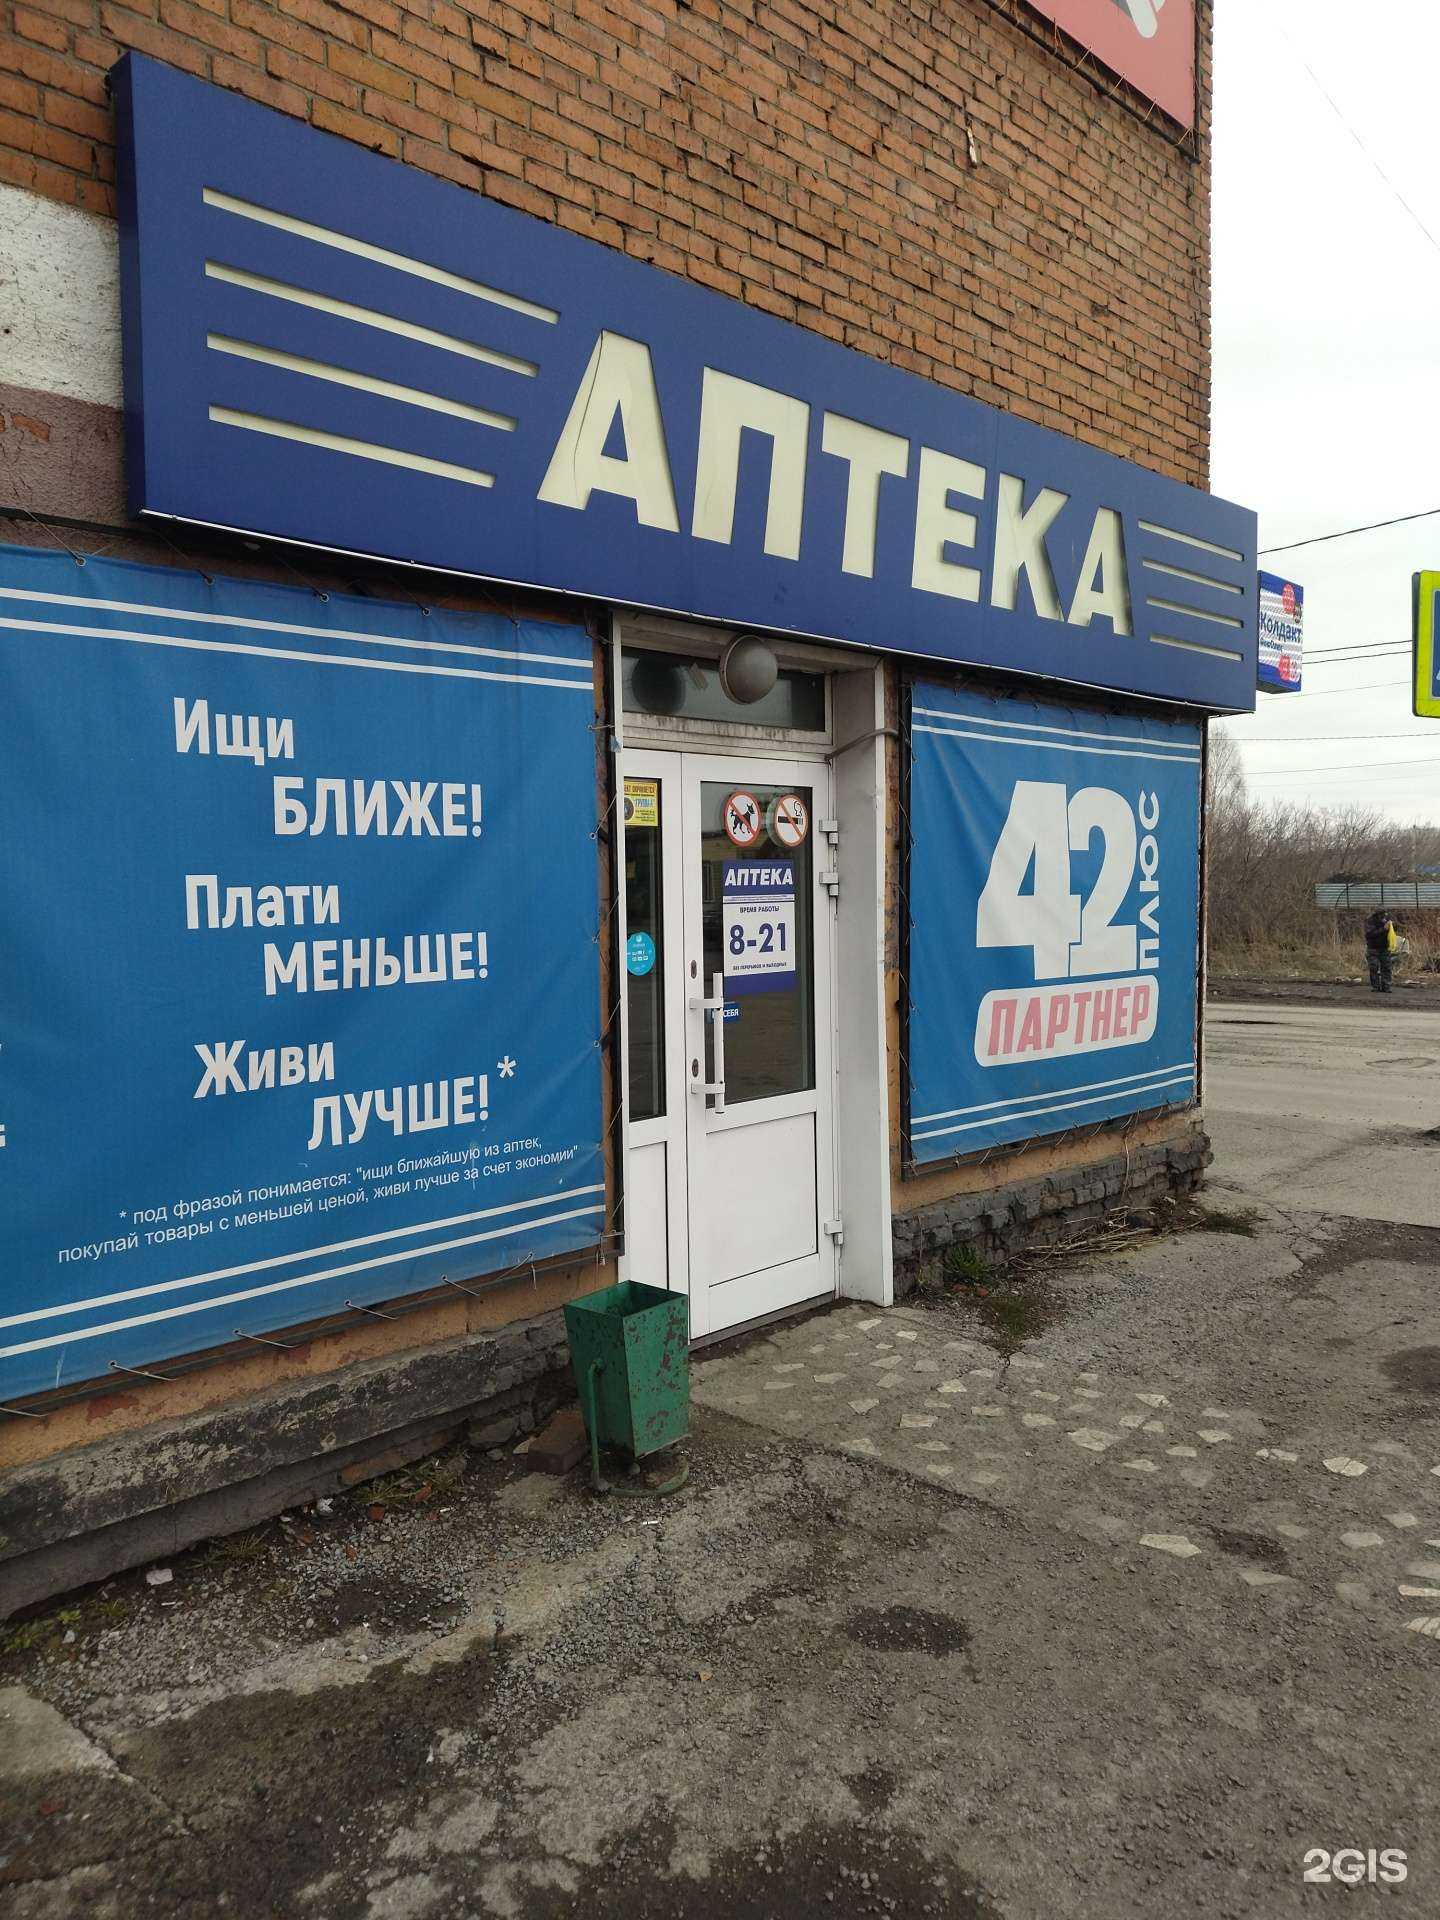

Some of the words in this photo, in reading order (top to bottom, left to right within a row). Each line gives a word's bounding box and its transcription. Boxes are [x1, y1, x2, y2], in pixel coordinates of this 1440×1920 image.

[536, 329, 1134, 637] АПТЕКА
[173, 697, 295, 765] Ищи
[273, 776, 482, 837] БЛИЖЕ!
[185, 874, 340, 929] Плати
[725, 868, 793, 886] АПТЕКА
[758, 905, 780, 913] РАБОТЫ
[976, 780, 1137, 980] 42
[1139, 790, 1160, 970] ПЛЮС
[264, 931, 488, 995] МЕНЬШЕ!
[729, 922, 786, 955] 8-21
[987, 985, 1151, 1057] ПАРТНЕР
[193, 1040, 335, 1098] Живи
[58, 1231, 139, 1263] покупай
[144, 1221, 213, 1245] товары
[219, 1217, 230, 1231] с
[234, 1198, 314, 1228] меньшей
[318, 1187, 369, 1213] ценой,
[373, 1181, 410, 1200] живи
[414, 1171, 460, 1192] лучше
[463, 1167, 479, 1181] за
[483, 1160, 512, 1177] счет
[515, 1145, 578, 1170] экономии"
[133, 1206, 168, 1225] под
[173, 1189, 242, 1220] фразой
[248, 1172, 352, 1202] понимается:
[356, 1163, 393, 1181] "ищи
[397, 1147, 480, 1174] ближайшую
[484, 1144, 500, 1158] из
[503, 1136, 542, 1153] аптек,
